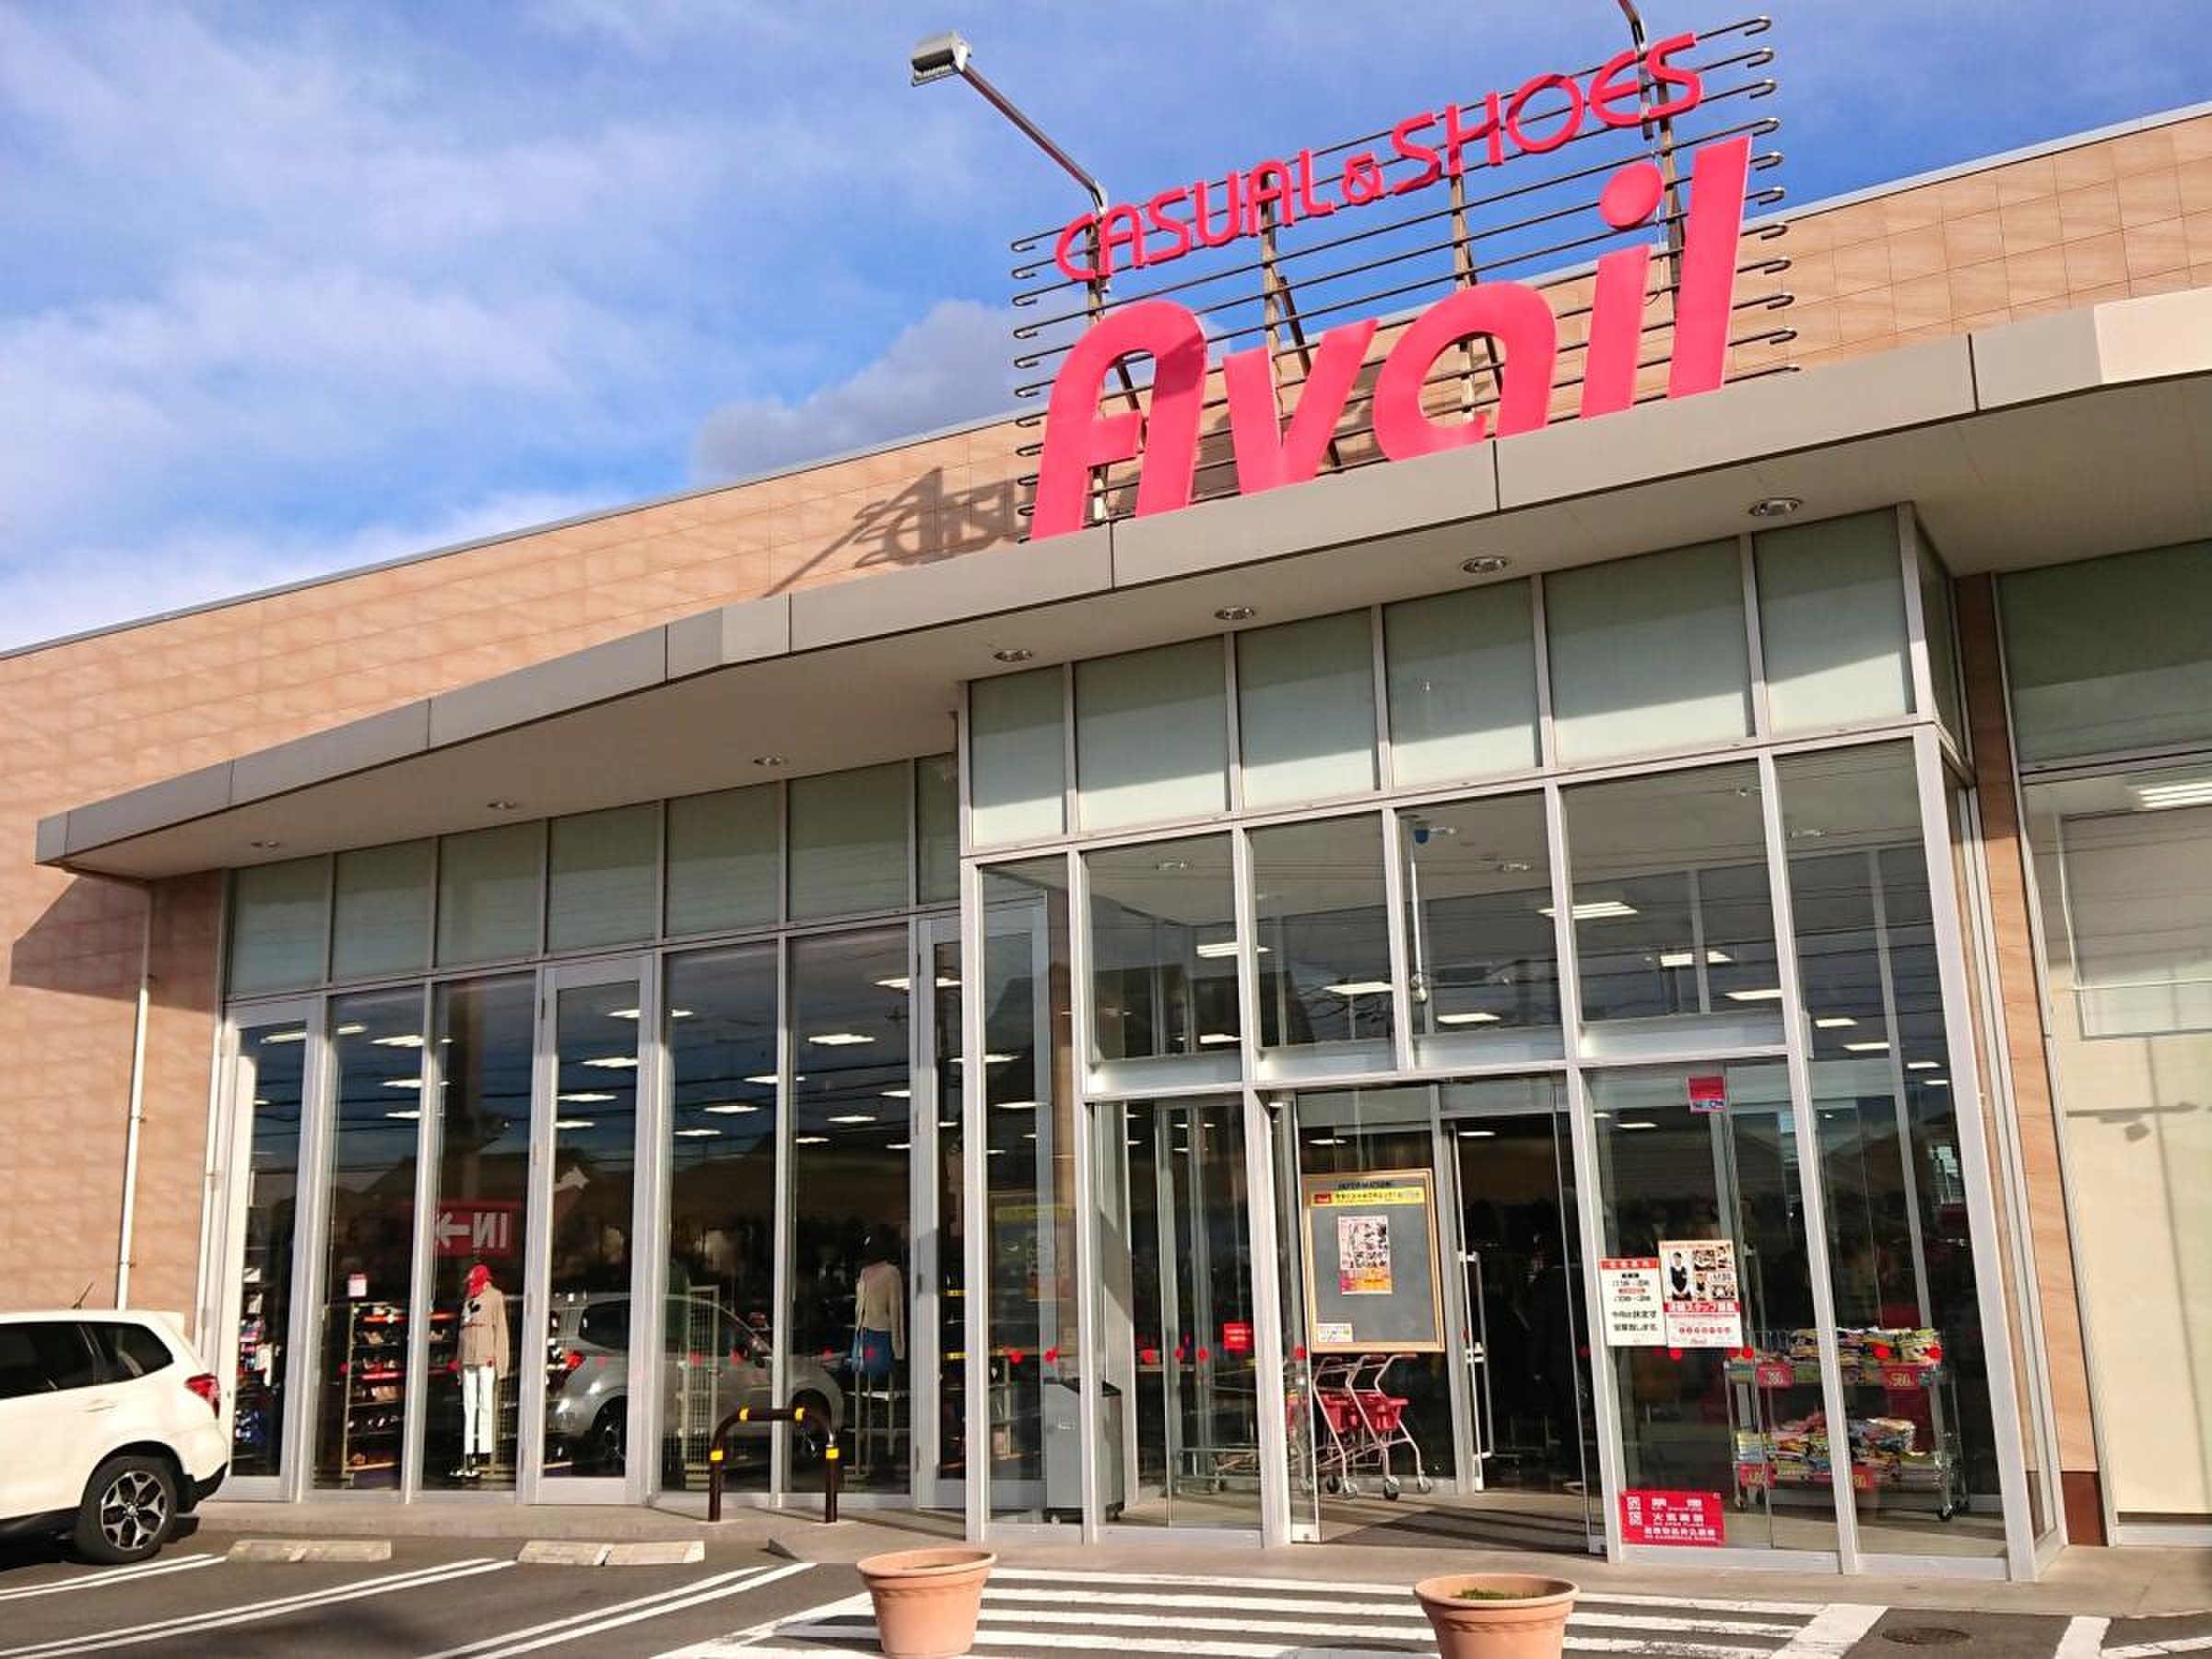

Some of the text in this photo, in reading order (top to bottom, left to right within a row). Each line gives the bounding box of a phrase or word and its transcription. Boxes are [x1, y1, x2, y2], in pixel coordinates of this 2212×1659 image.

[1054, 149, 1337, 281] CASUAL
[1391, 32, 1704, 194] SHOES
[1030, 135, 1753, 541] Avail
